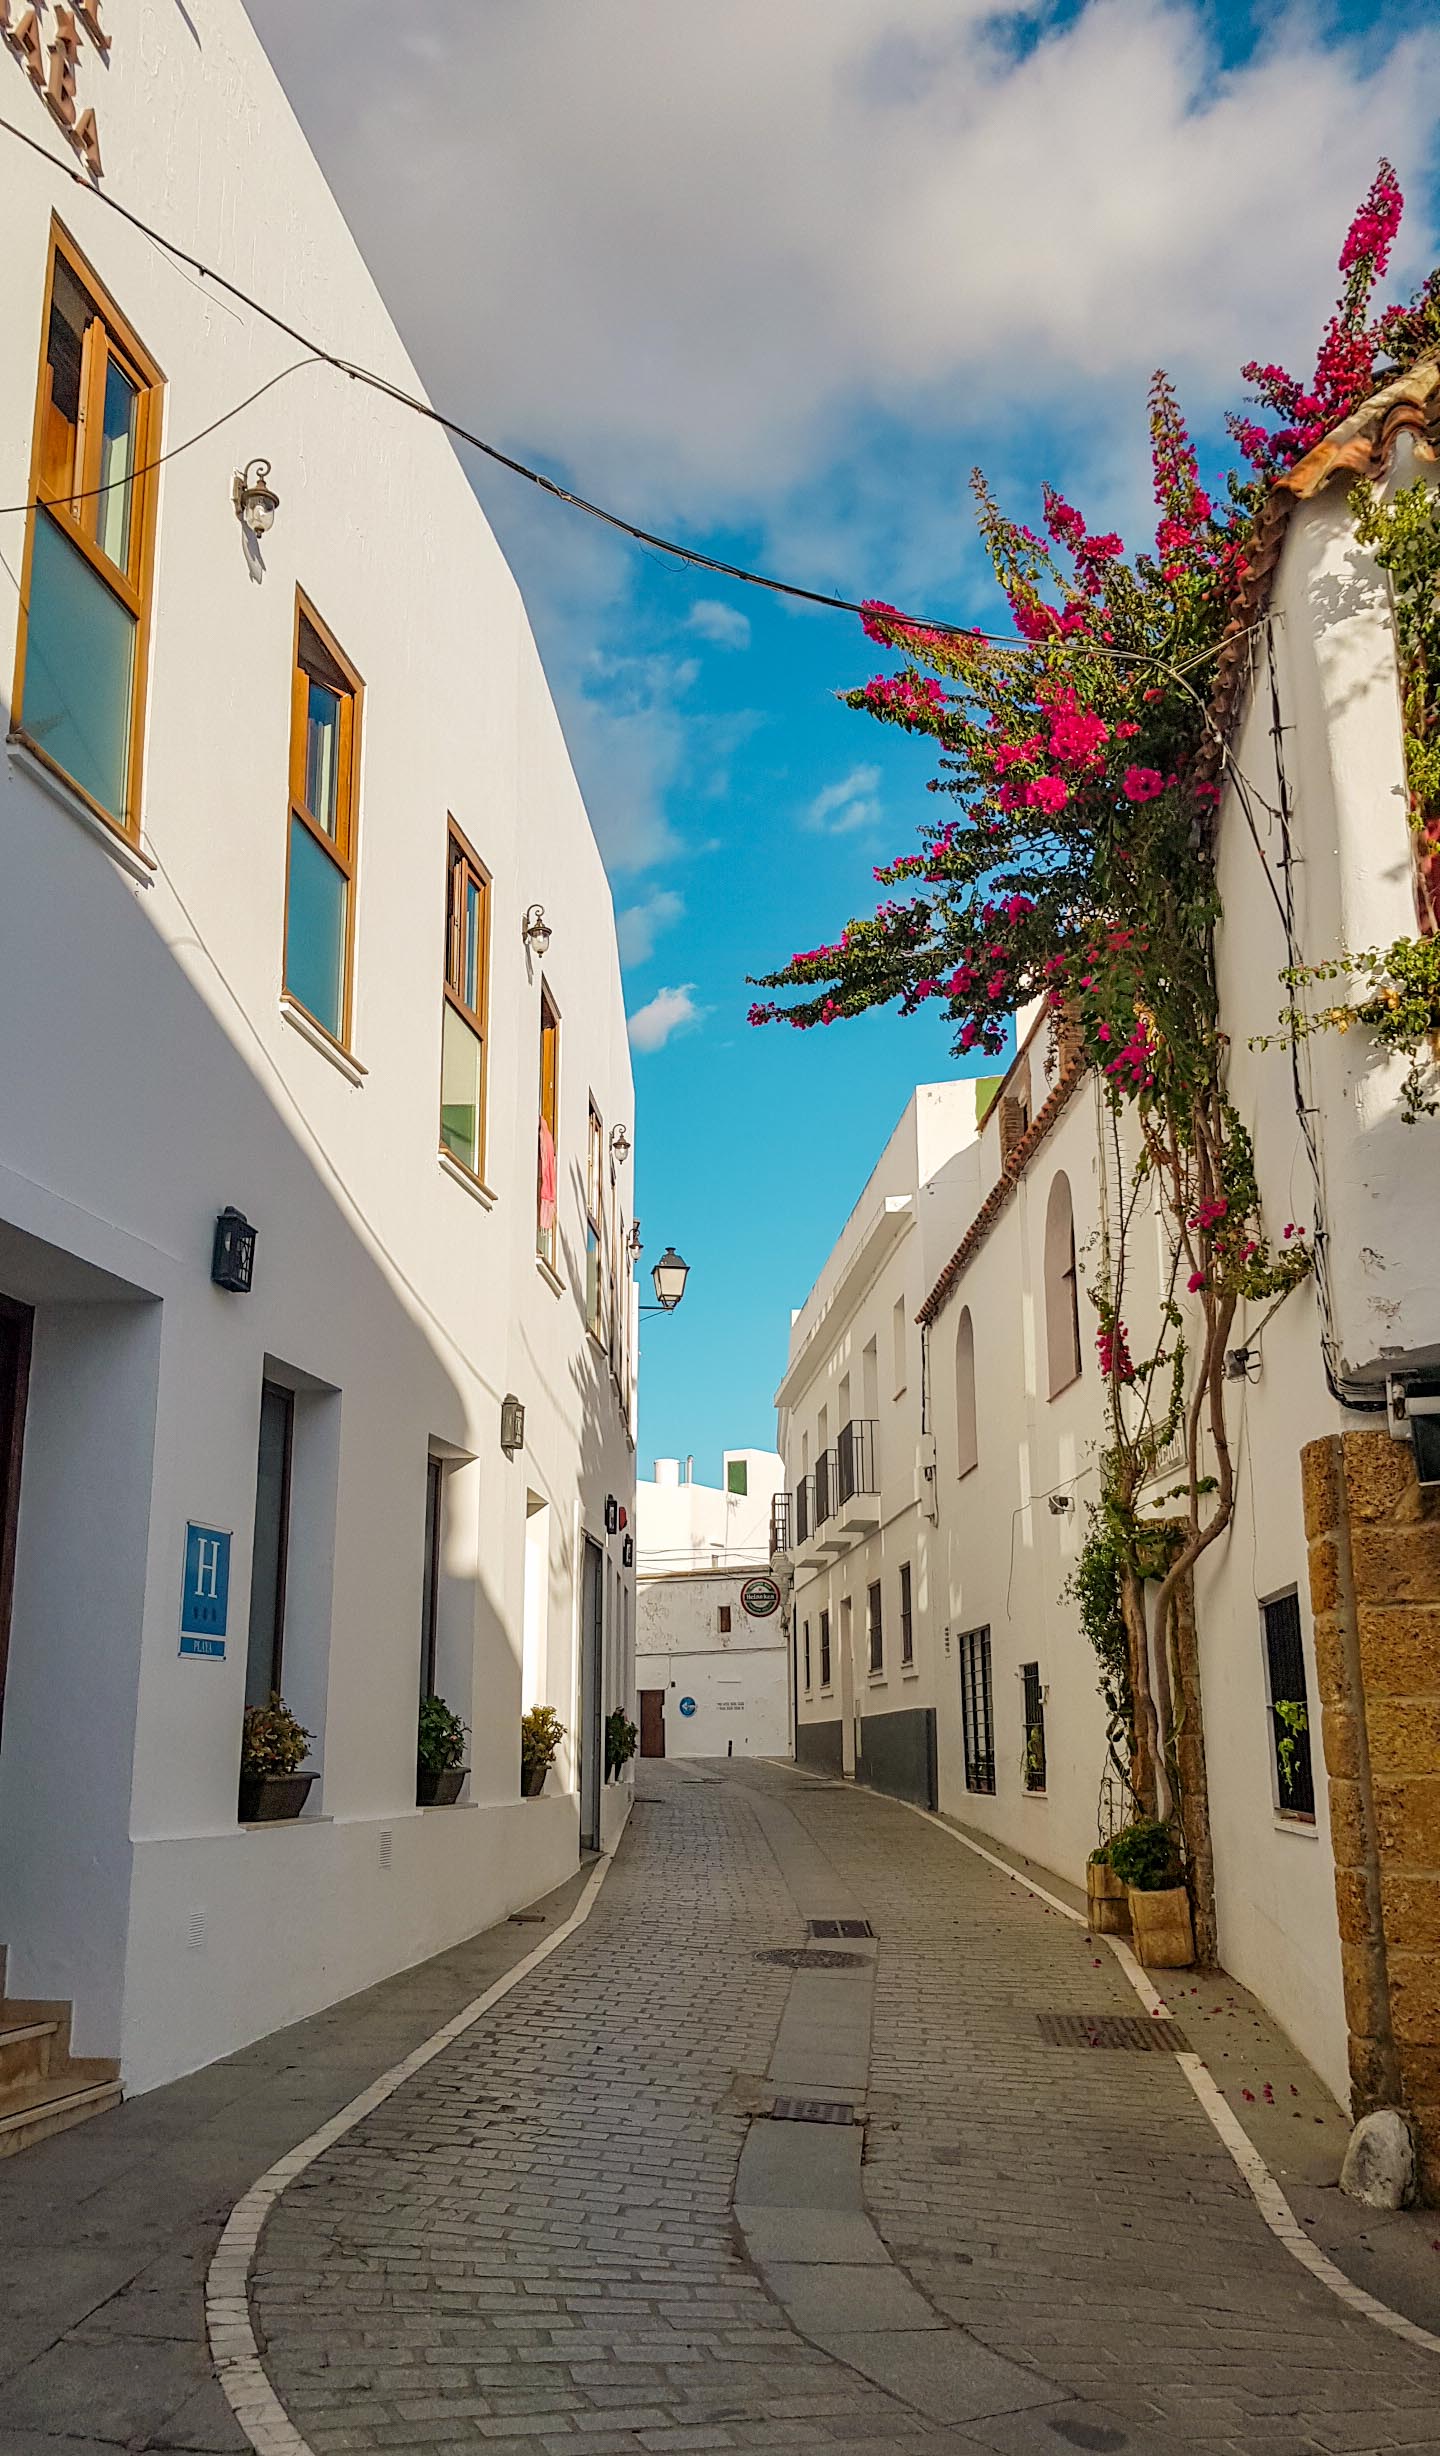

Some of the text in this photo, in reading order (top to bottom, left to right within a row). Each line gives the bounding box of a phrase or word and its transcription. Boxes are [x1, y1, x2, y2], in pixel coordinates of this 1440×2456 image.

[0, 0, 105, 178] ABA
[194, 1537, 221, 1599] H
[193, 1640, 213, 1654] PLAYA
